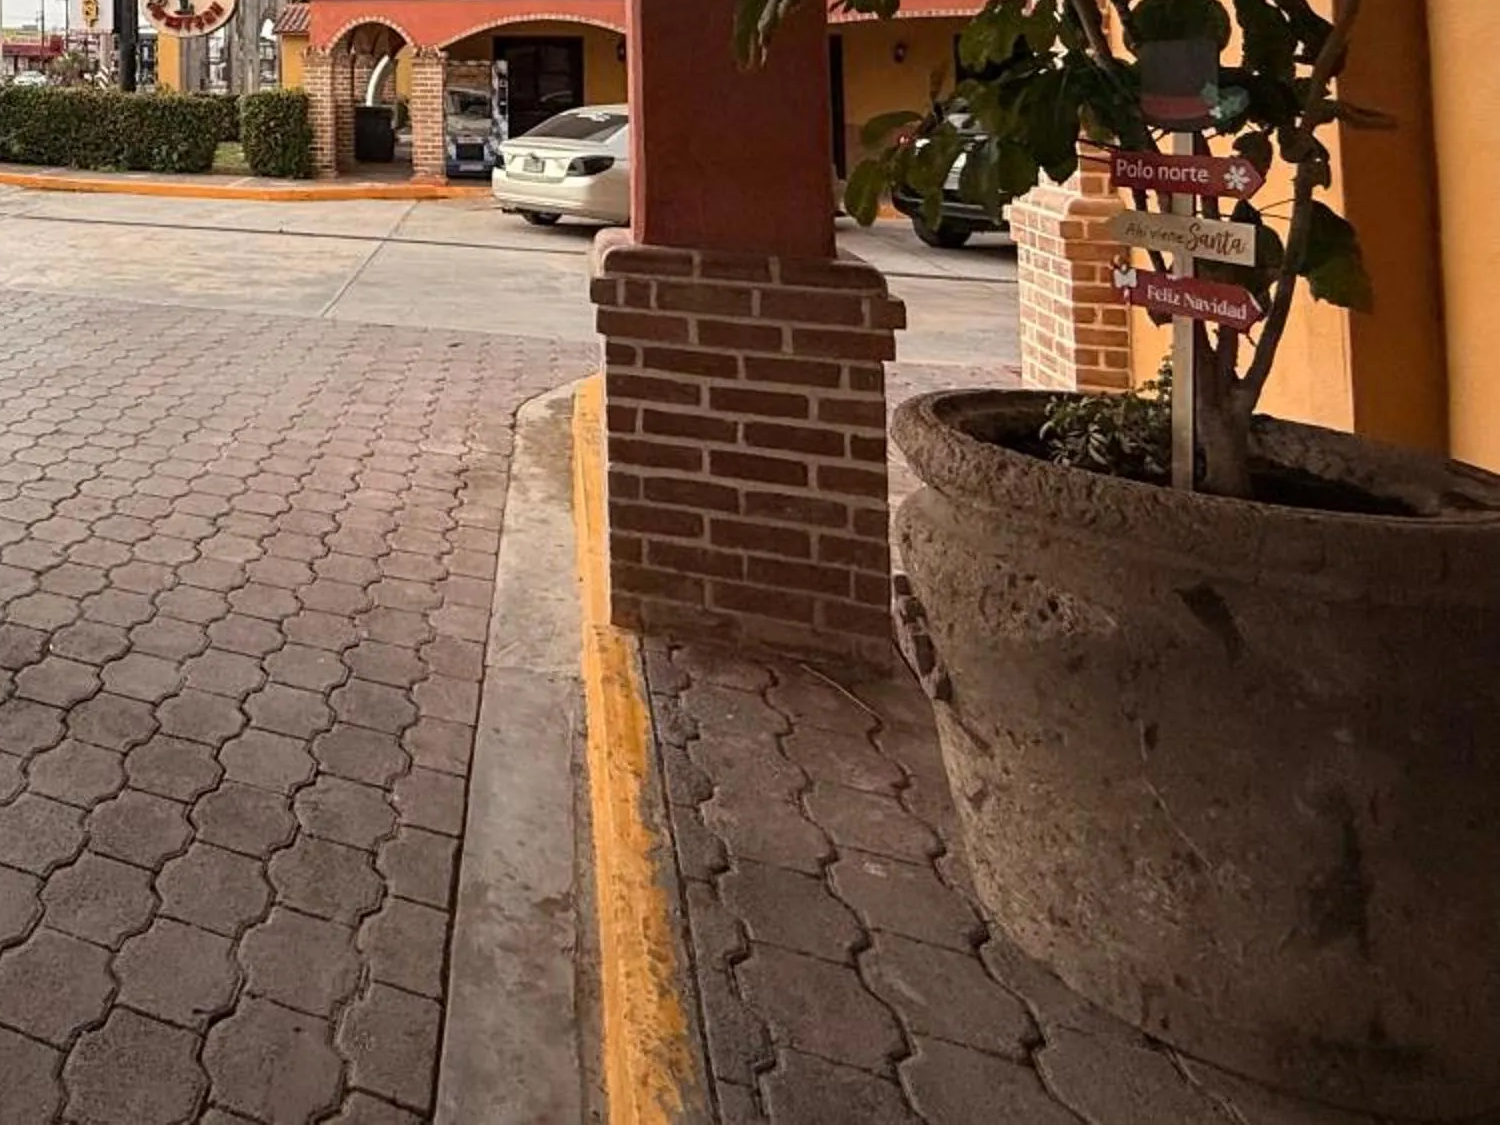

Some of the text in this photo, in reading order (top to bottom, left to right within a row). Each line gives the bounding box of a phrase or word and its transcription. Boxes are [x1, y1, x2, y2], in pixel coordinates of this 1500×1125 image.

[1115, 159, 1210, 183] Polo norte
[1186, 223, 1246, 255] Santa
[1147, 284, 1247, 320] Feliz Navidad
